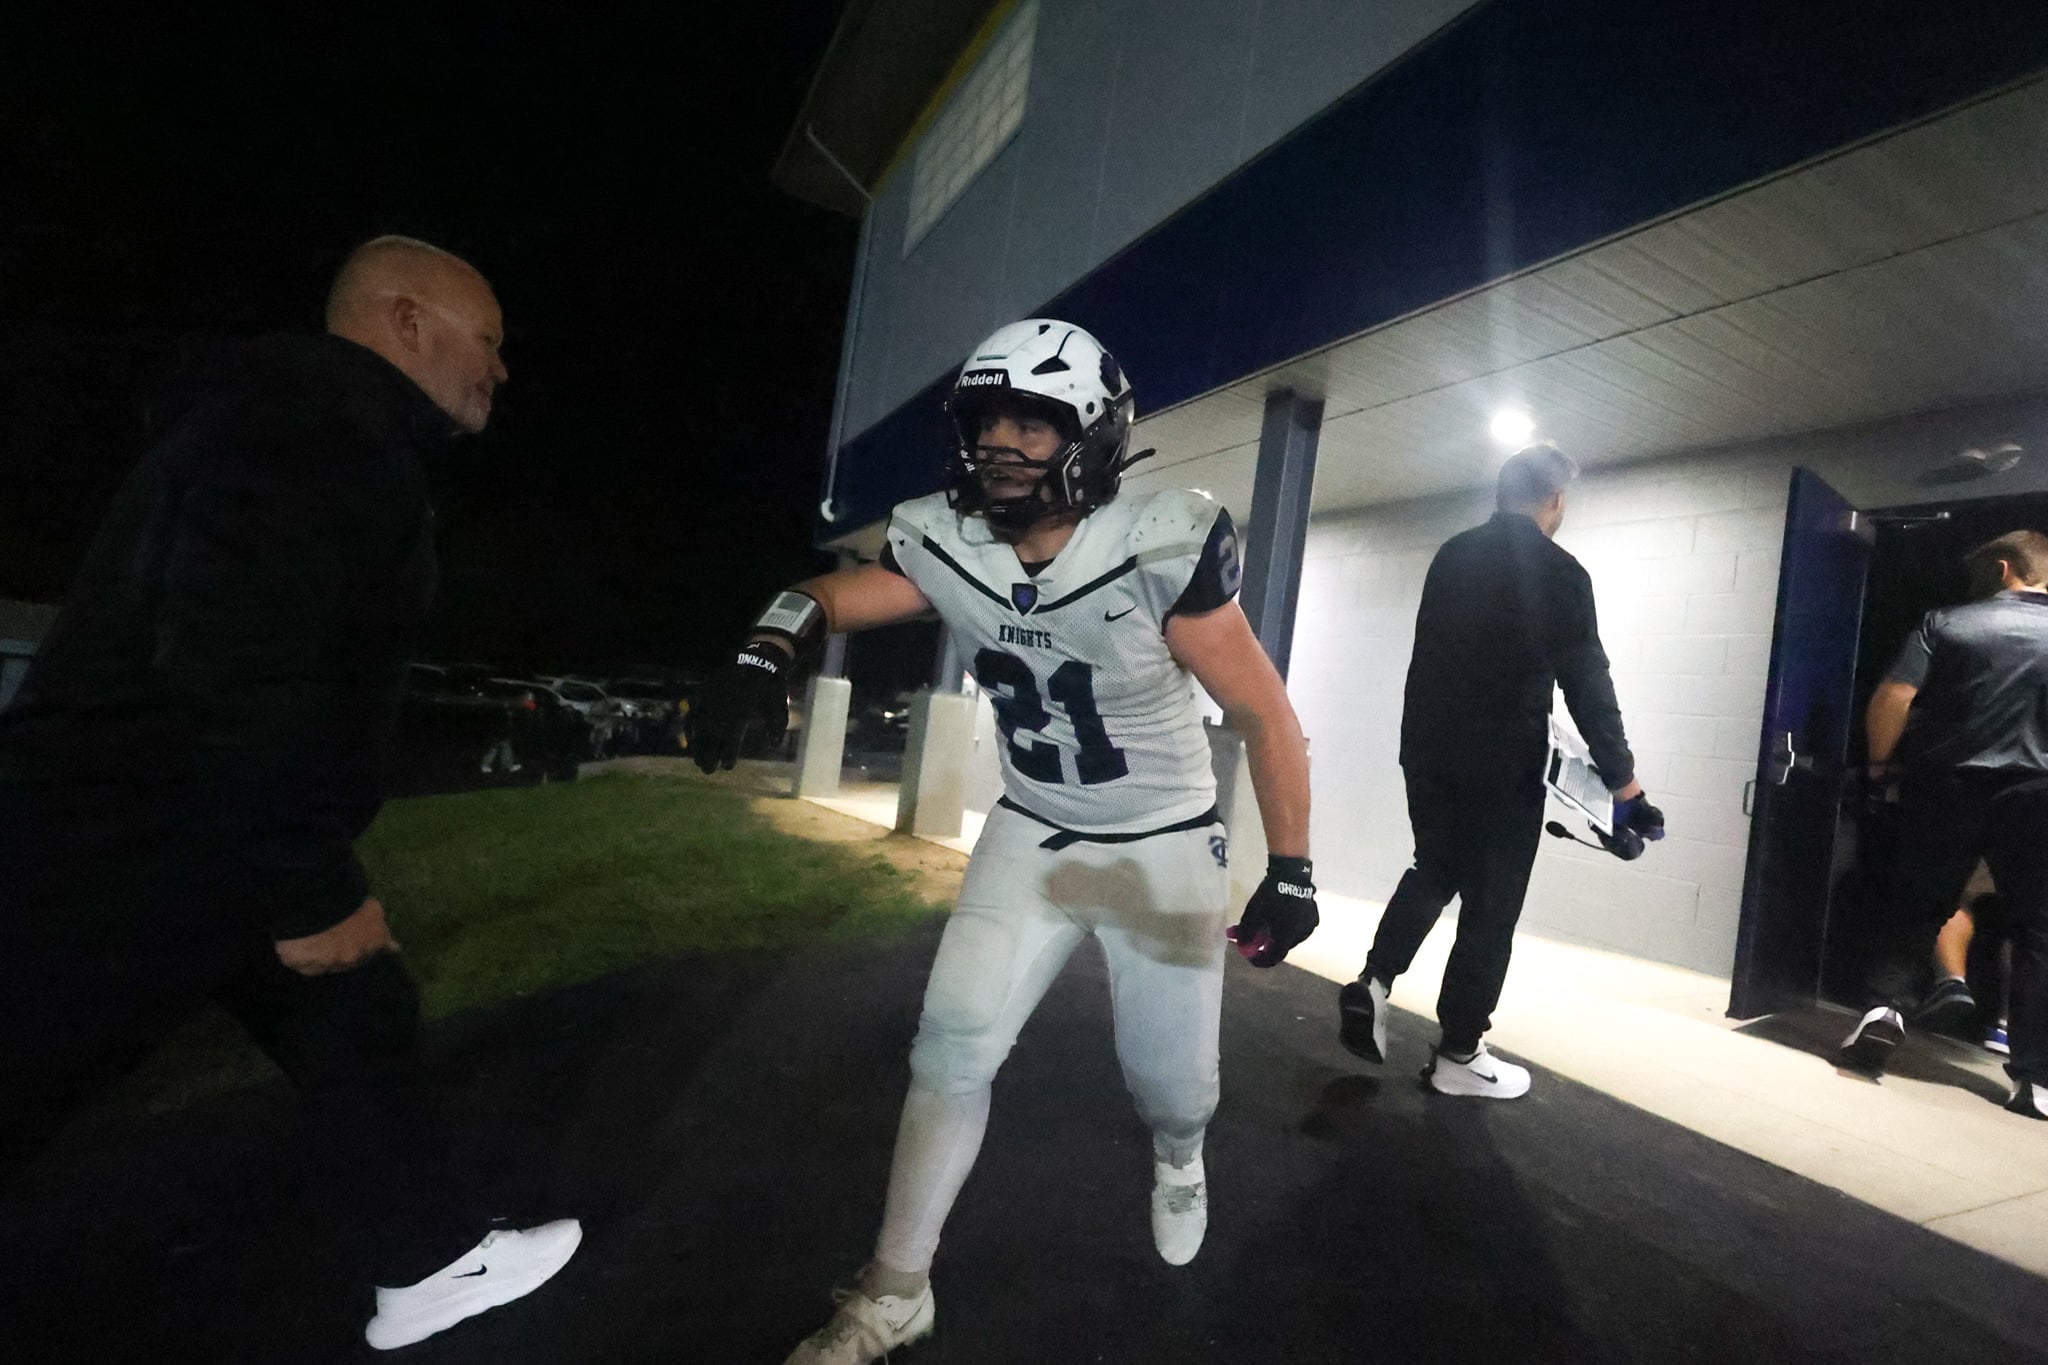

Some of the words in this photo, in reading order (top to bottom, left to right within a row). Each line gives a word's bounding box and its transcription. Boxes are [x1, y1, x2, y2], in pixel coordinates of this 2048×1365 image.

[961, 373, 1004, 387] Riddell
[1219, 534, 1241, 595] 2
[998, 624, 1052, 649] KNIGHTS
[737, 653, 778, 674] NXTRND
[974, 647, 1130, 785] 21
